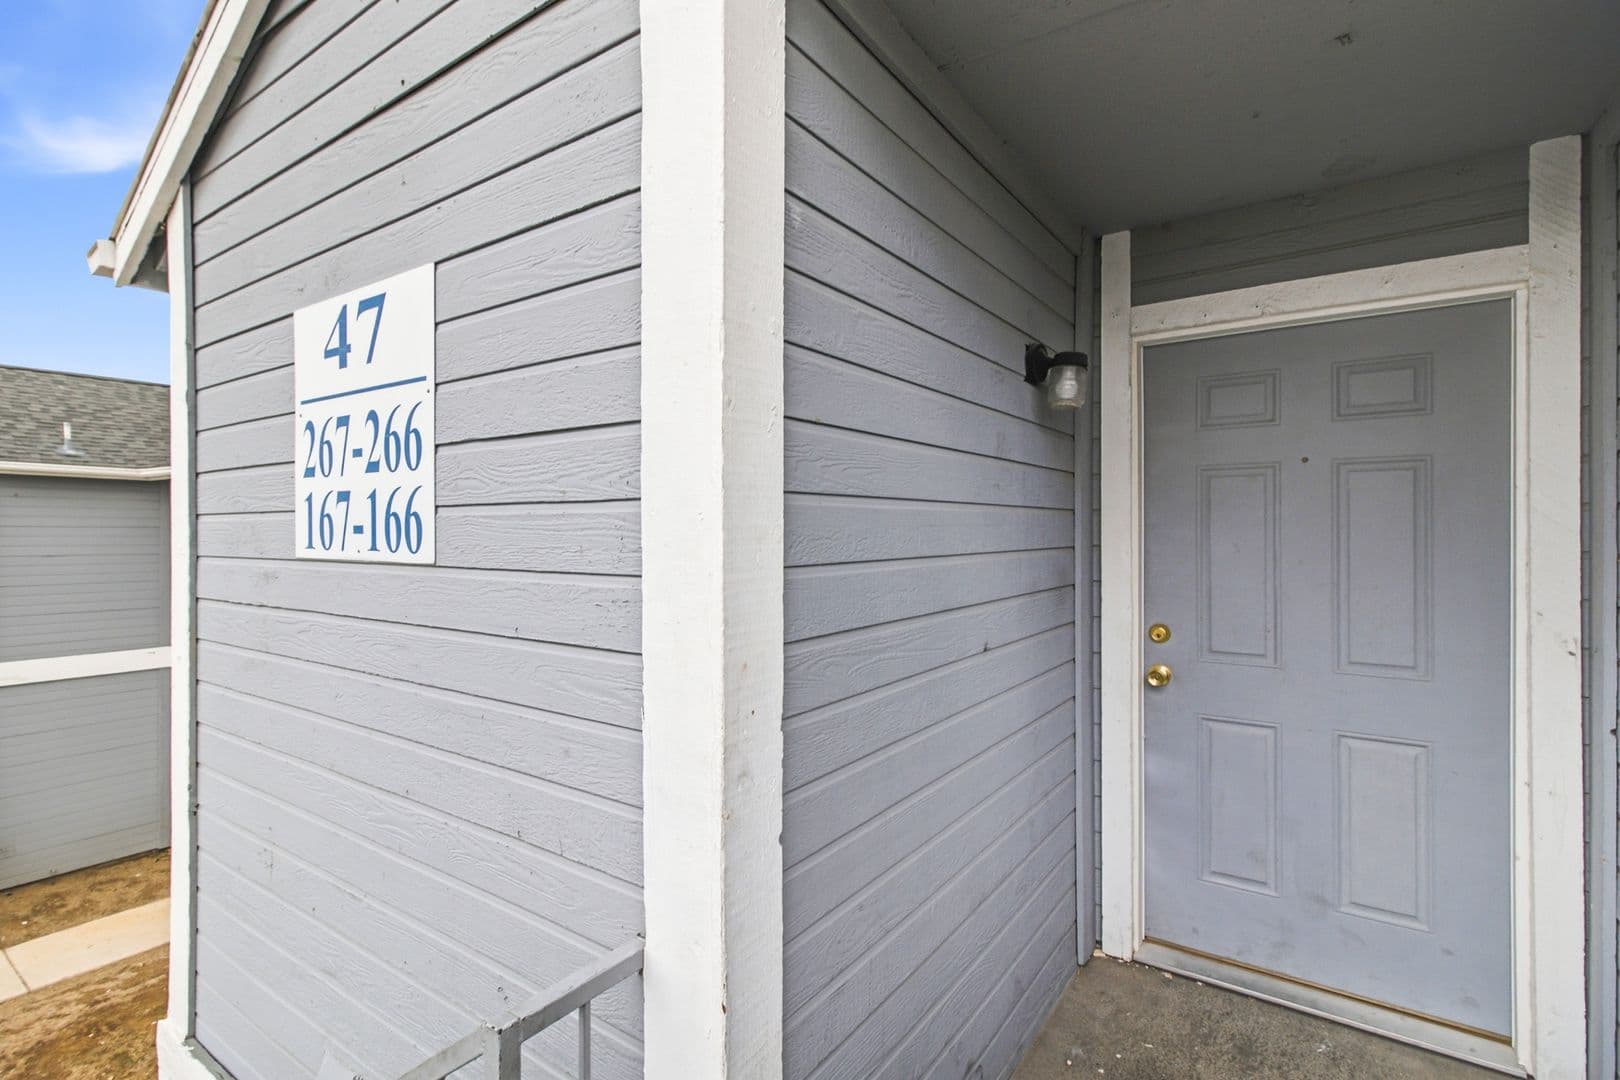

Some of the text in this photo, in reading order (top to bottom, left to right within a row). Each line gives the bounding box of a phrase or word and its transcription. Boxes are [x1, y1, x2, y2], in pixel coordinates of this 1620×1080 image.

[323, 292, 386, 369] 47
[303, 401, 423, 478] 267-266
[304, 485, 423, 554] 167-166
